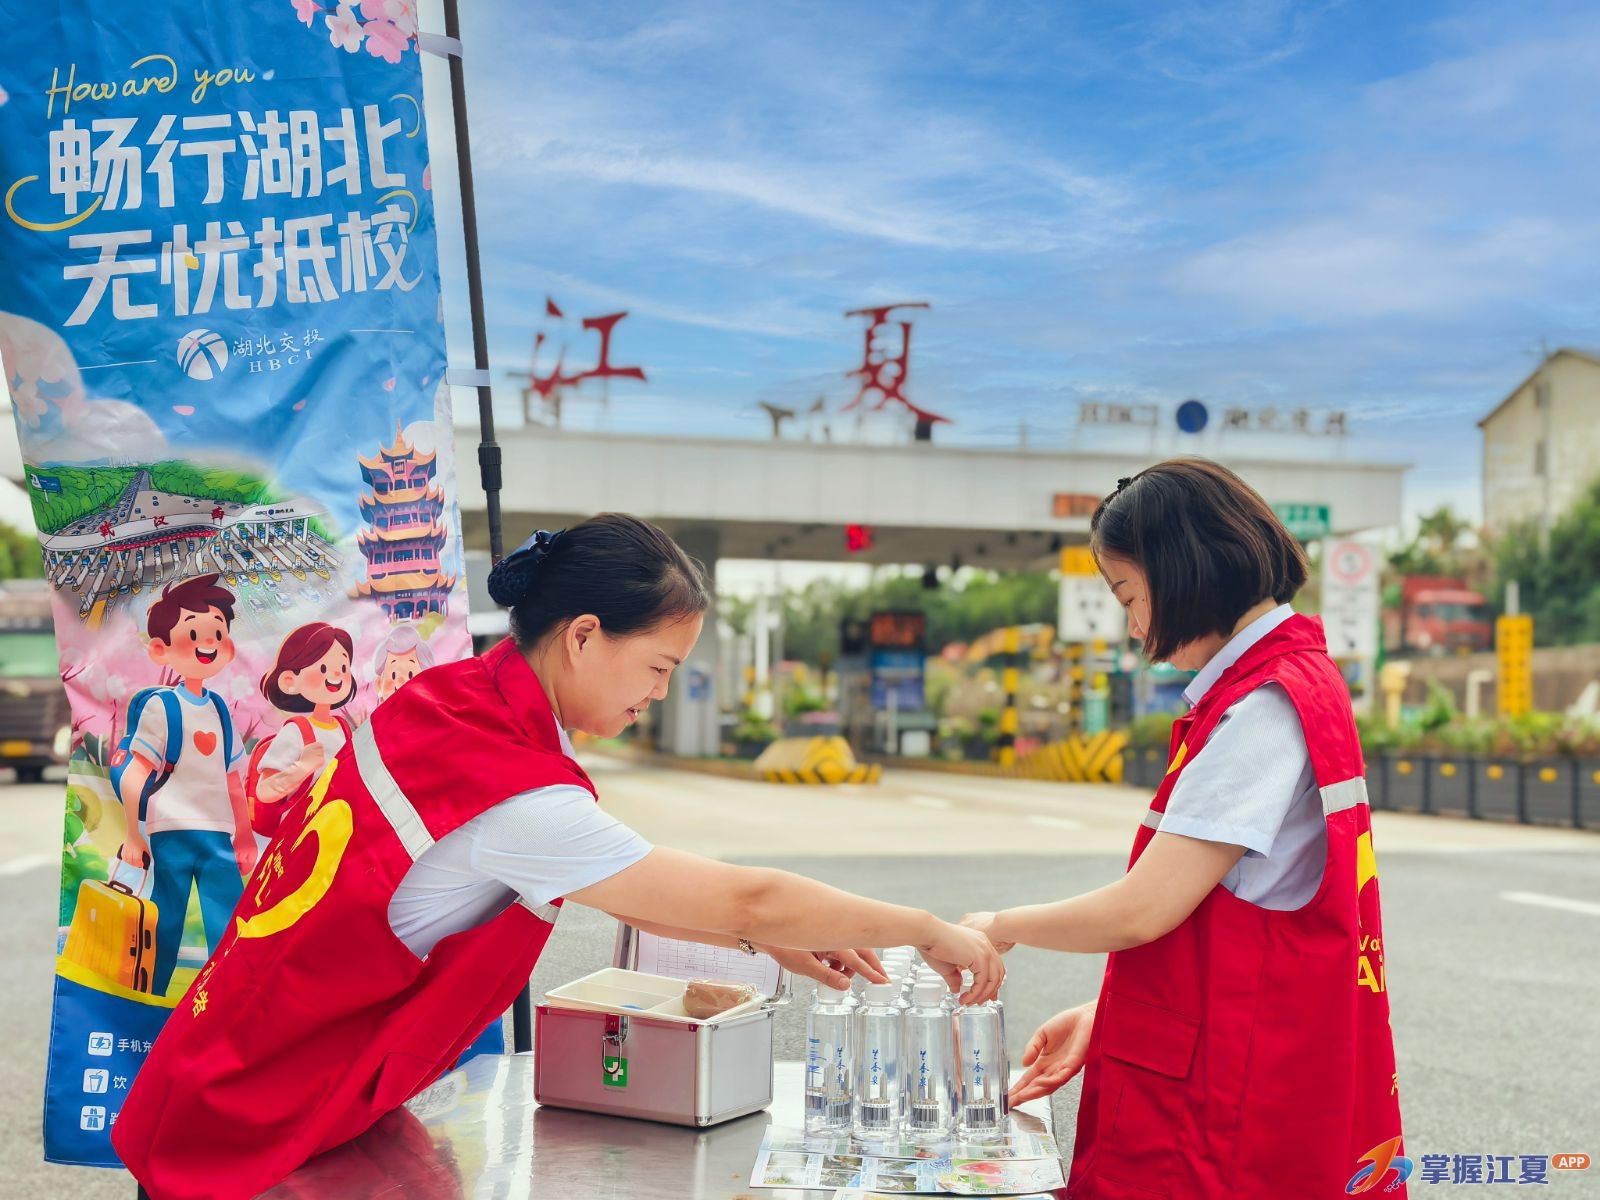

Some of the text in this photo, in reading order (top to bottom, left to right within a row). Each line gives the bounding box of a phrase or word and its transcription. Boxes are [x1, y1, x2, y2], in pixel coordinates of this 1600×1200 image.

[46, 54, 256, 119] How are you
[49, 104, 406, 215] 畅行湖北
[63, 204, 413, 326] 无忧抵校
[232, 328, 325, 358] 湖北交投
[249, 349, 313, 373] HBCI
